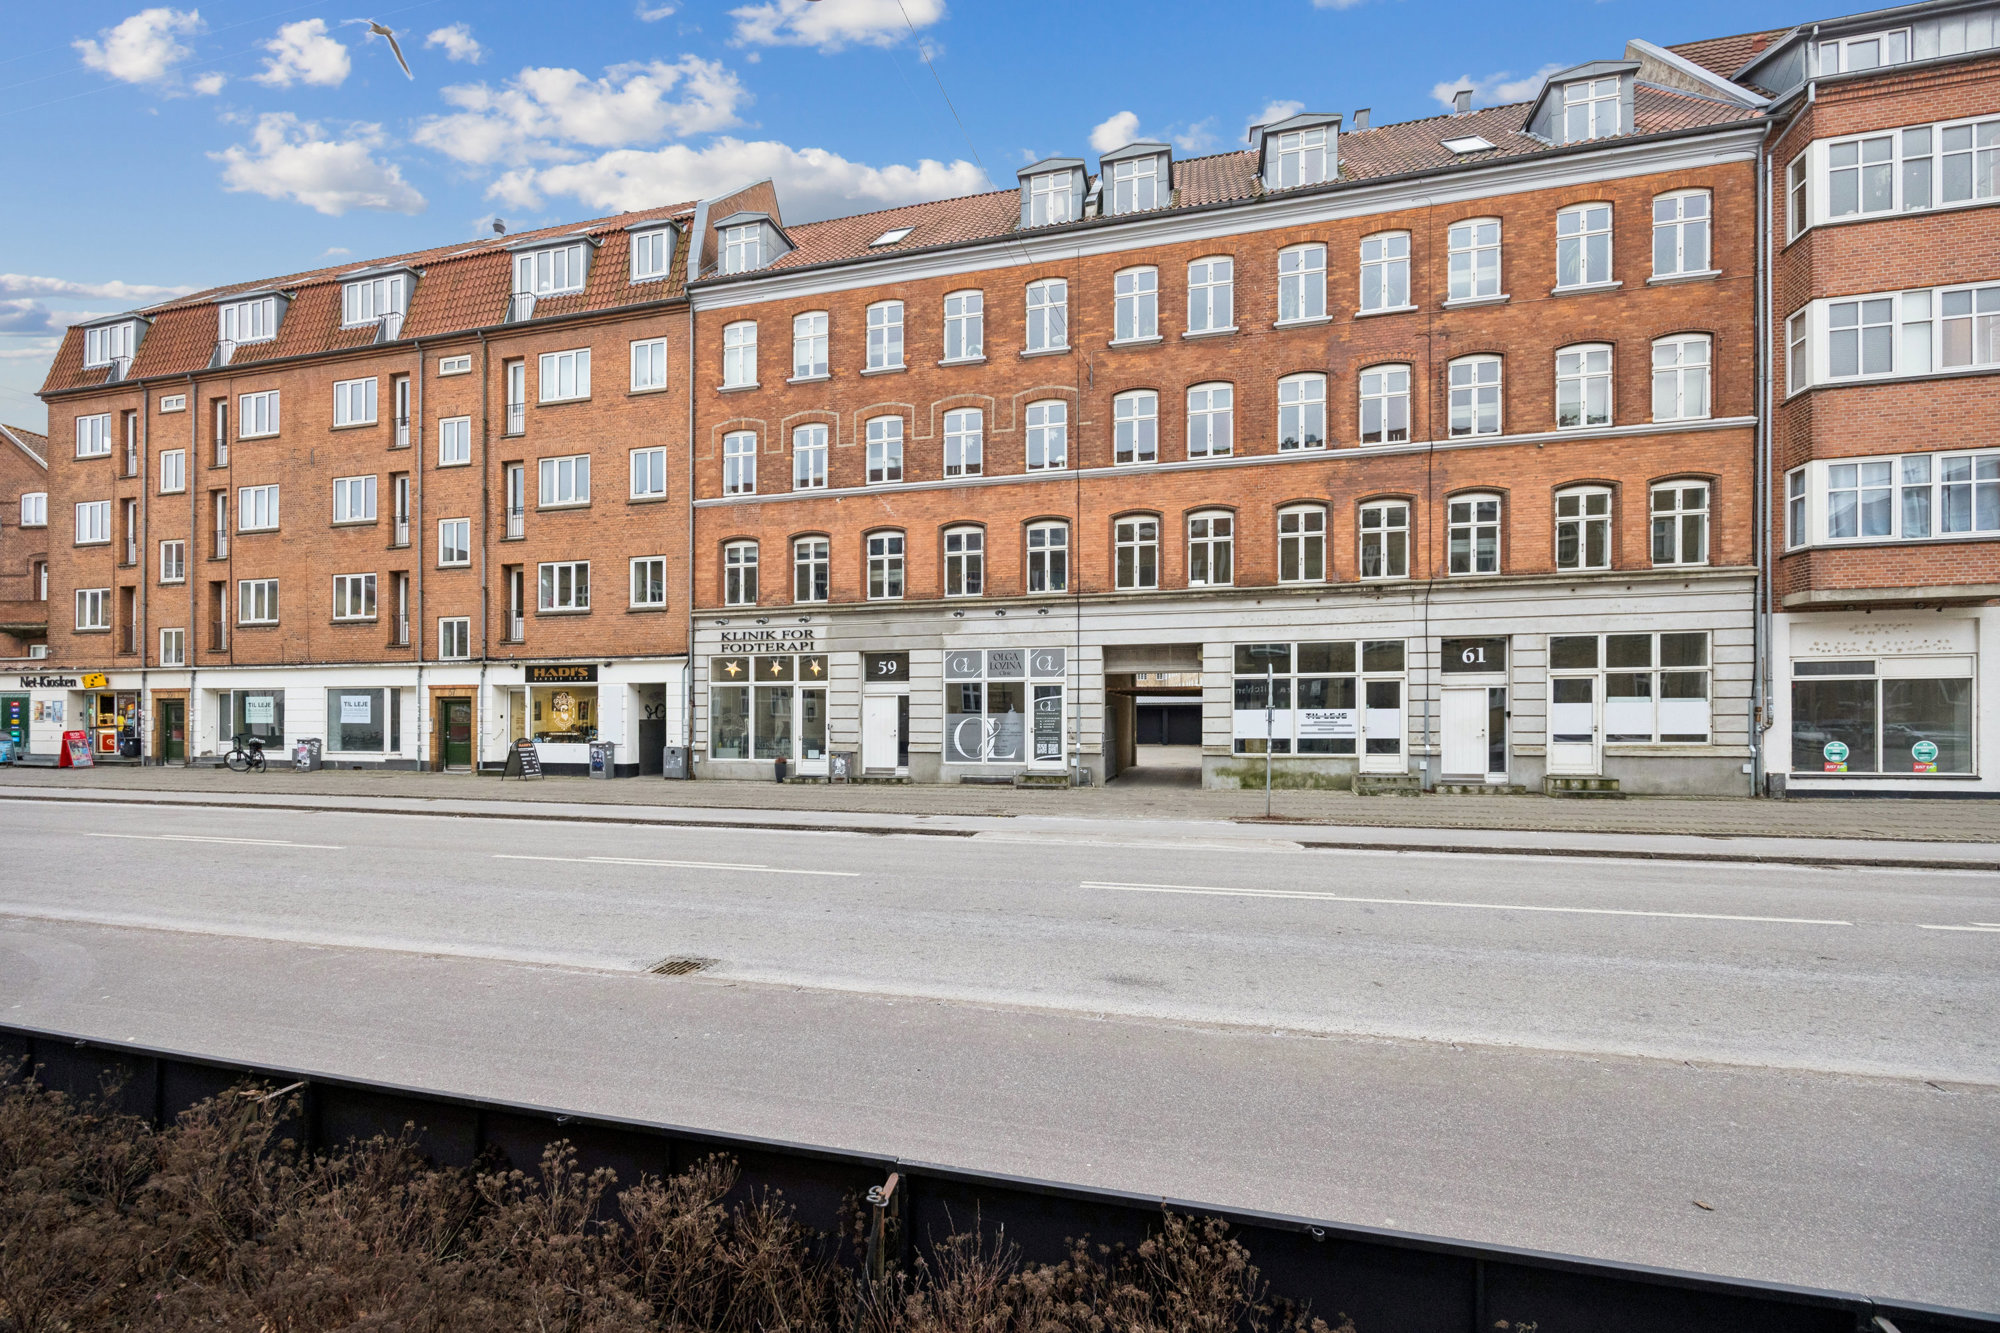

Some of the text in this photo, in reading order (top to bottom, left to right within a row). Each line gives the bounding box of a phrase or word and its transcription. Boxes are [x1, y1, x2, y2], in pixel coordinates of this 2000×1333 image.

[721, 629, 814, 641] KLINIK FOR
[721, 641, 816, 653] FODTERAPI
[993, 652, 1019, 661] OLGA
[1462, 647, 1487, 664] 61
[878, 660, 897, 675] 59
[990, 661, 1022, 670] LOZINA
[534, 667, 589, 677] HADI'S
[20, 676, 77, 688] Net-Kiosken
